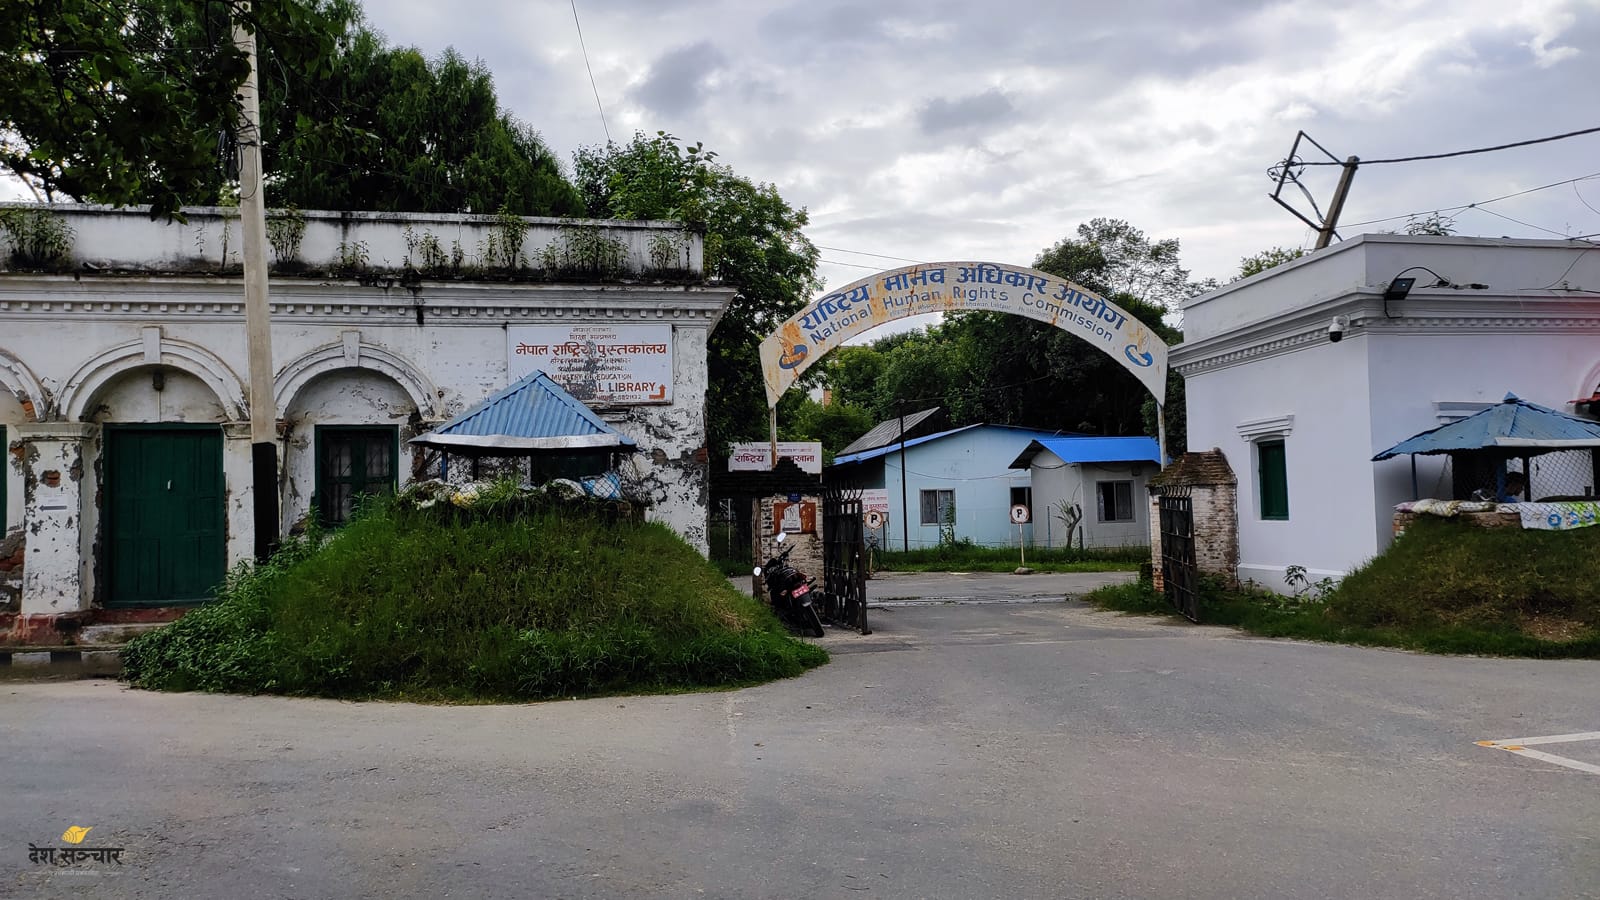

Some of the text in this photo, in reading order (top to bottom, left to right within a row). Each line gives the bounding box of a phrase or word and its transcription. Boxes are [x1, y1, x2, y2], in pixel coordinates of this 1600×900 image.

[797, 283, 869, 330] राष्ट्रिय
[882, 267, 947, 291] मानव
[956, 263, 1050, 295] अधिकार
[1053, 281, 1128, 331] आयोग
[809, 303, 872, 345] National
[883, 290, 941, 310] Human
[952, 286, 1009, 301] Rights
[1022, 292, 1113, 342] Commission
[515, 342, 548, 356] नेपाल
[597, 343, 667, 358] पुस्तकालय
[608, 382, 656, 393] LIBRARY
[734, 453, 764, 464] राष्ट्रिय
[1016, 508, 1023, 518] P
[870, 514, 878, 524] P
